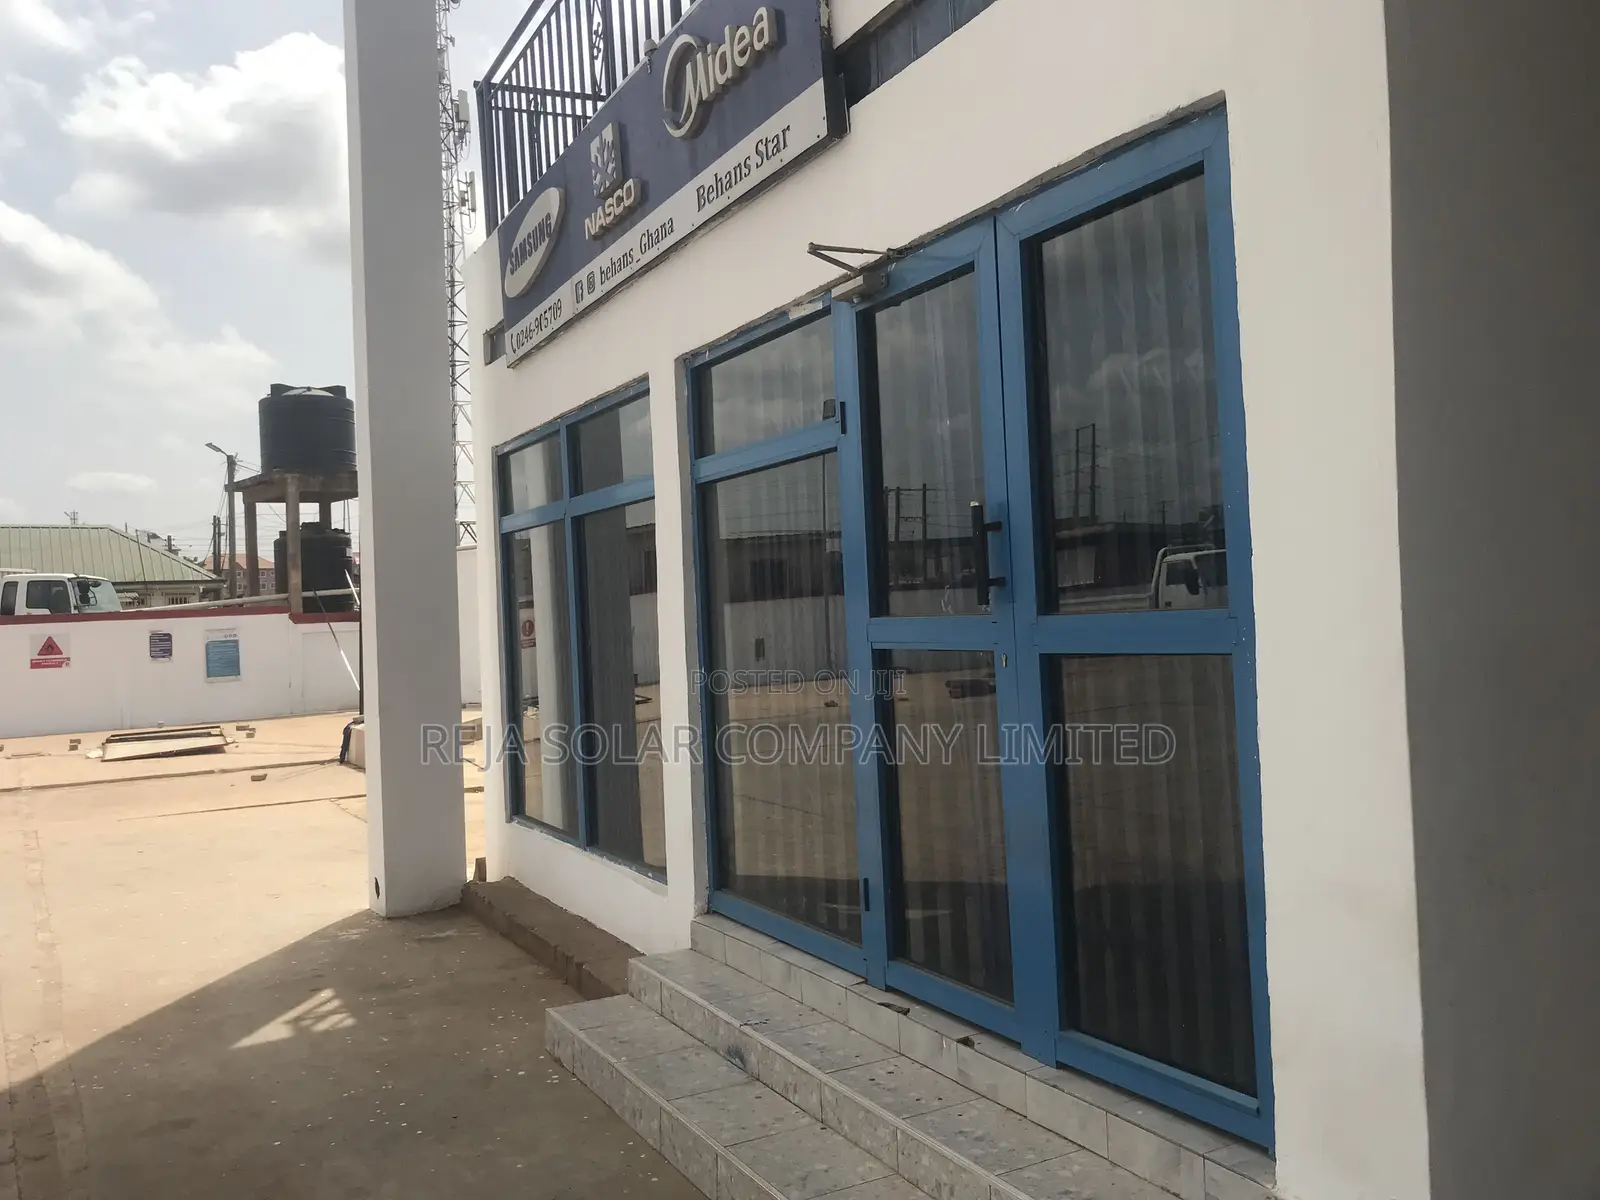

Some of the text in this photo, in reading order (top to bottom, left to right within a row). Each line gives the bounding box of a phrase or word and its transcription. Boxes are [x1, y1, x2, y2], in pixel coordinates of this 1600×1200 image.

[662, 6, 776, 139] Midea
[509, 212, 553, 276] SAMSUNG
[584, 178, 636, 240] NASCO
[599, 217, 675, 286] behans_Ghana
[695, 145, 752, 213] Behans
[753, 124, 792, 170] Star
